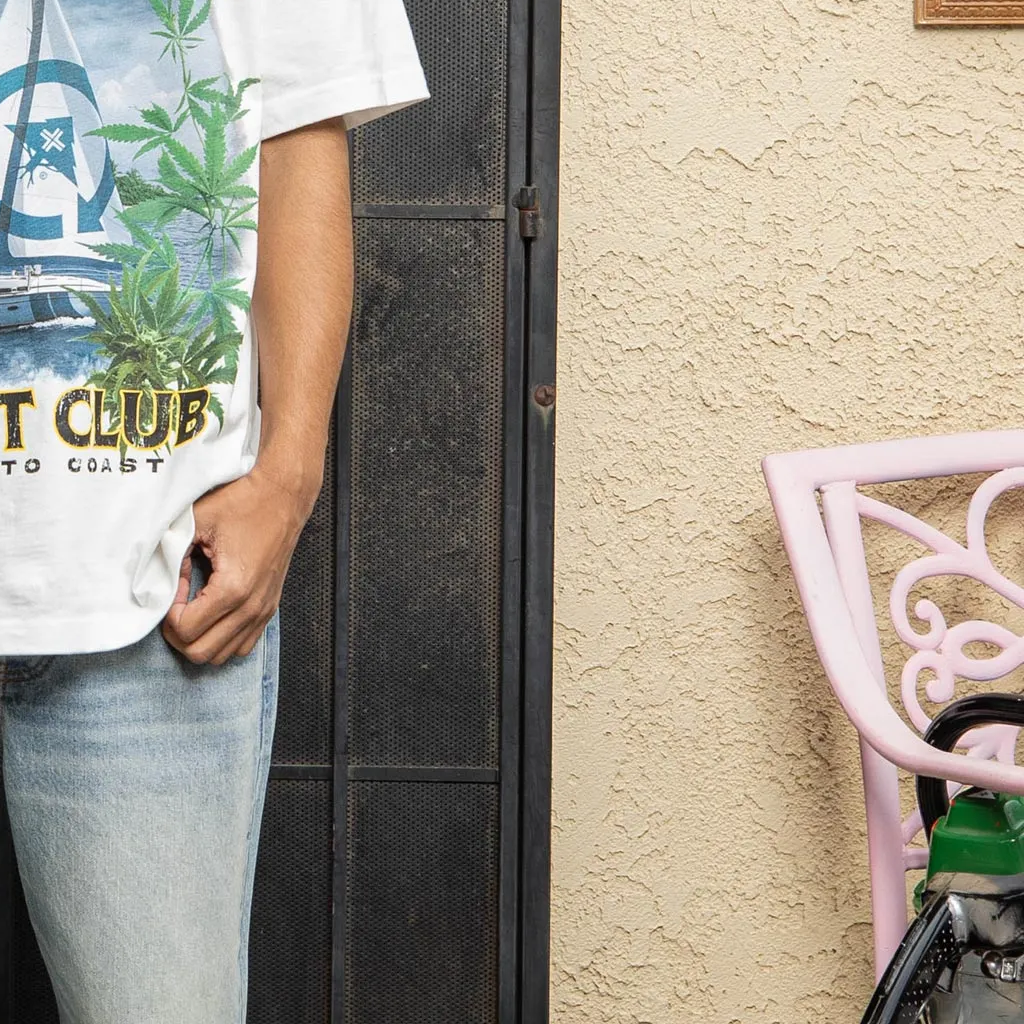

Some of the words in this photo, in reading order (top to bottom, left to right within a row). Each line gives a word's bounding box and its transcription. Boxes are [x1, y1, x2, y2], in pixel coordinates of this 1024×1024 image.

[55, 386, 209, 451] CLUB
[1, 458, 41, 475] TO
[68, 457, 165, 475] COAST
